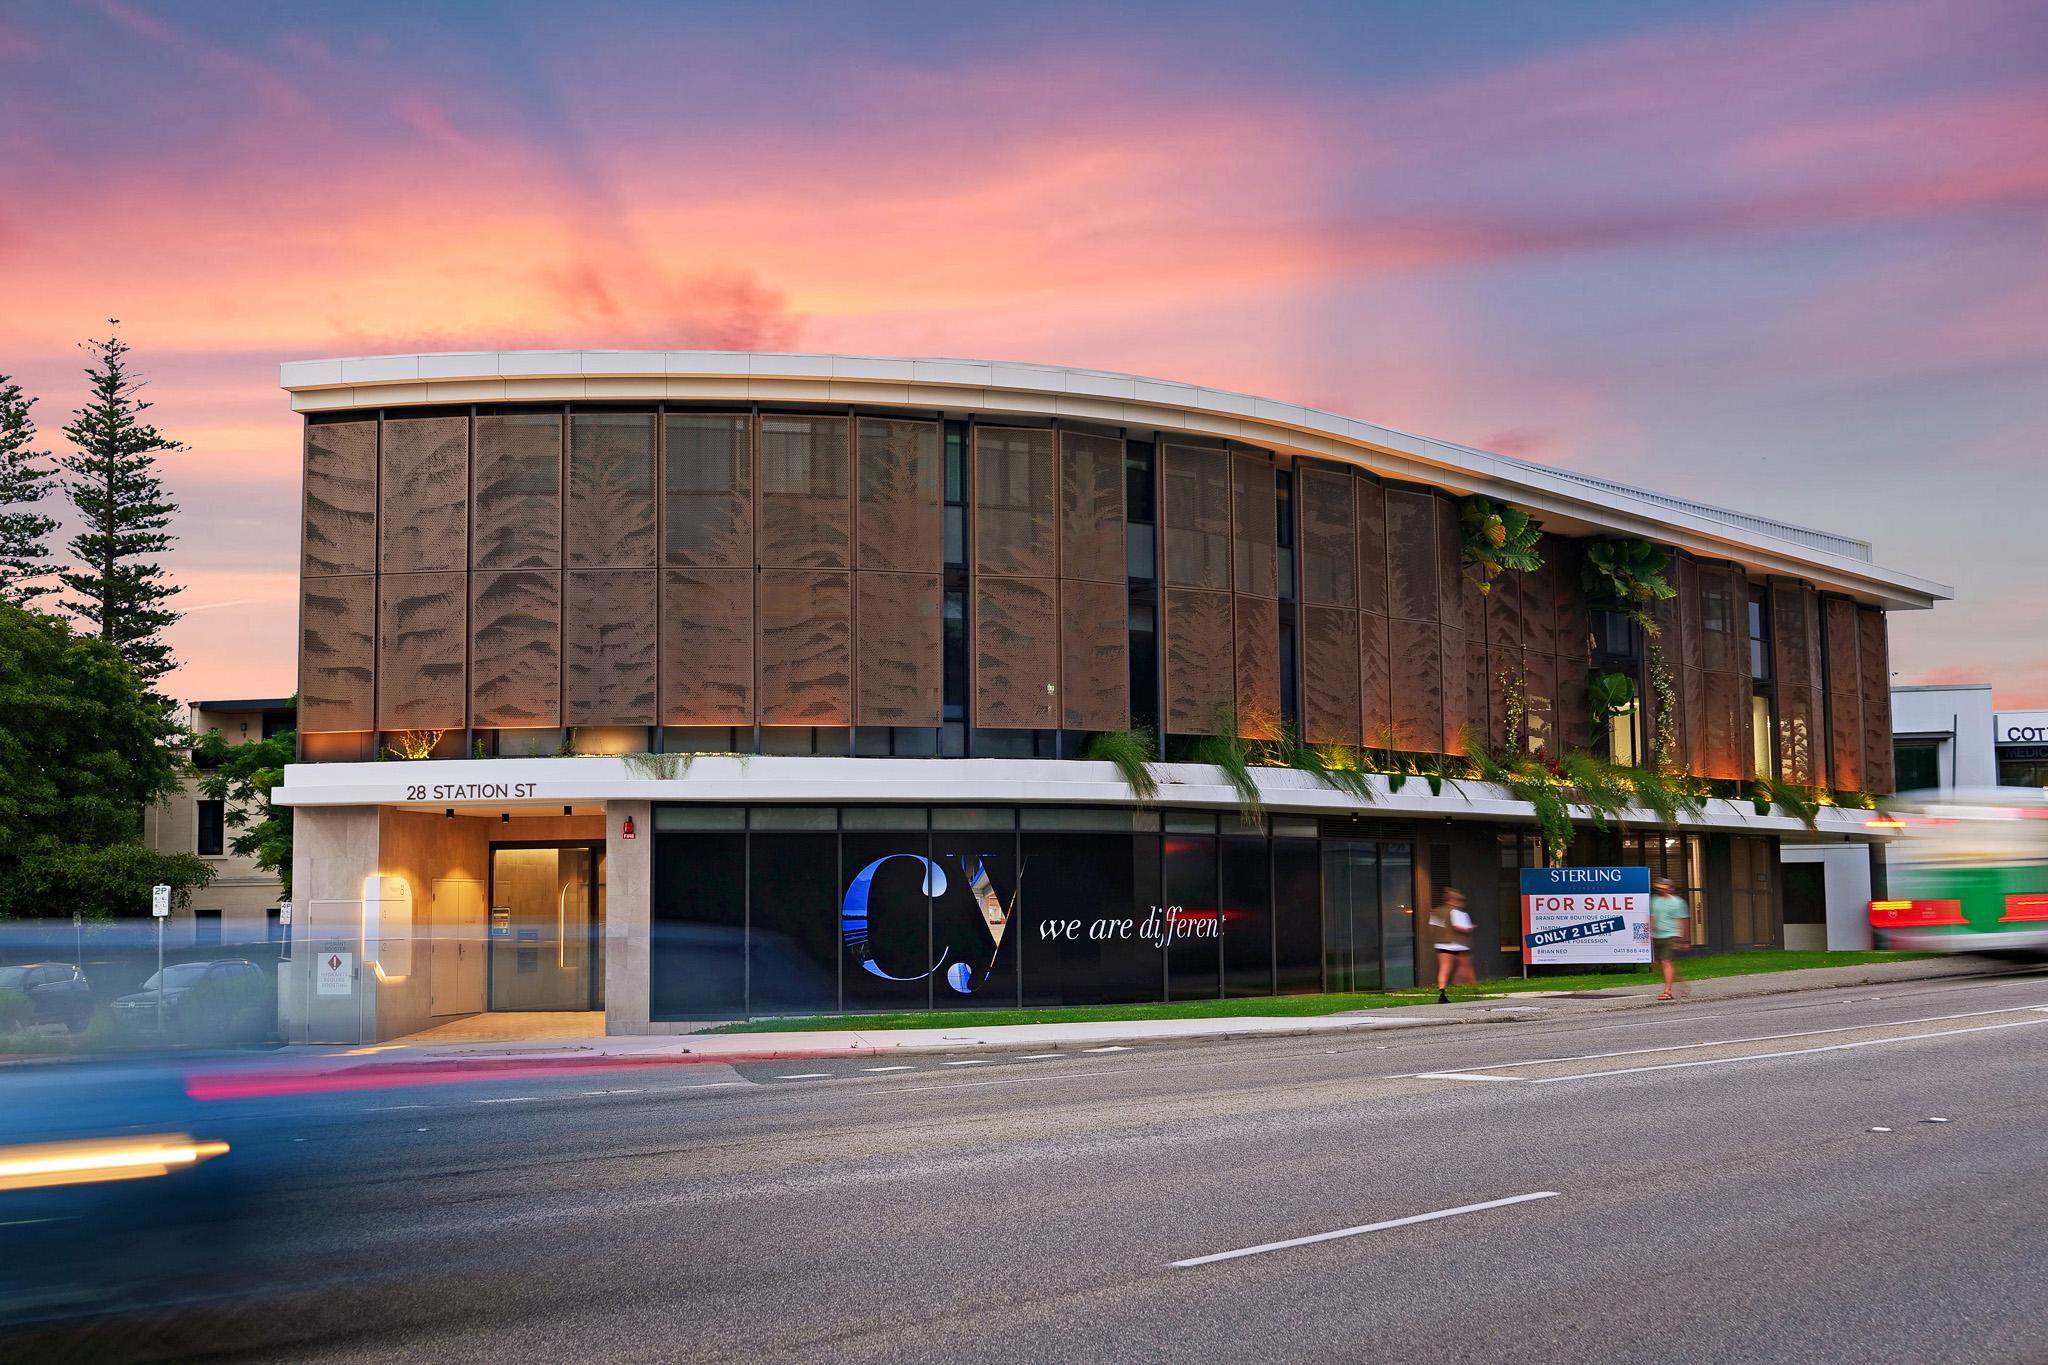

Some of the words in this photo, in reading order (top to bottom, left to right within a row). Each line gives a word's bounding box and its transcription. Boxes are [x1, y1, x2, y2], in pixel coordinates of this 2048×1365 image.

[2008, 726, 2048, 741] COT
[407, 785, 426, 800] 28
[433, 784, 508, 799] STATION
[514, 783, 537, 797] ST
[1550, 869, 1622, 882] STERLING
[1536, 898, 1574, 911] FOR
[1584, 897, 1634, 911] SALE
[1039, 918, 1082, 940] we
[1089, 918, 1133, 940] are
[1535, 929, 1567, 945] ONLY
[1572, 928, 1580, 938] 2
[1583, 920, 1615, 935] LEFT
